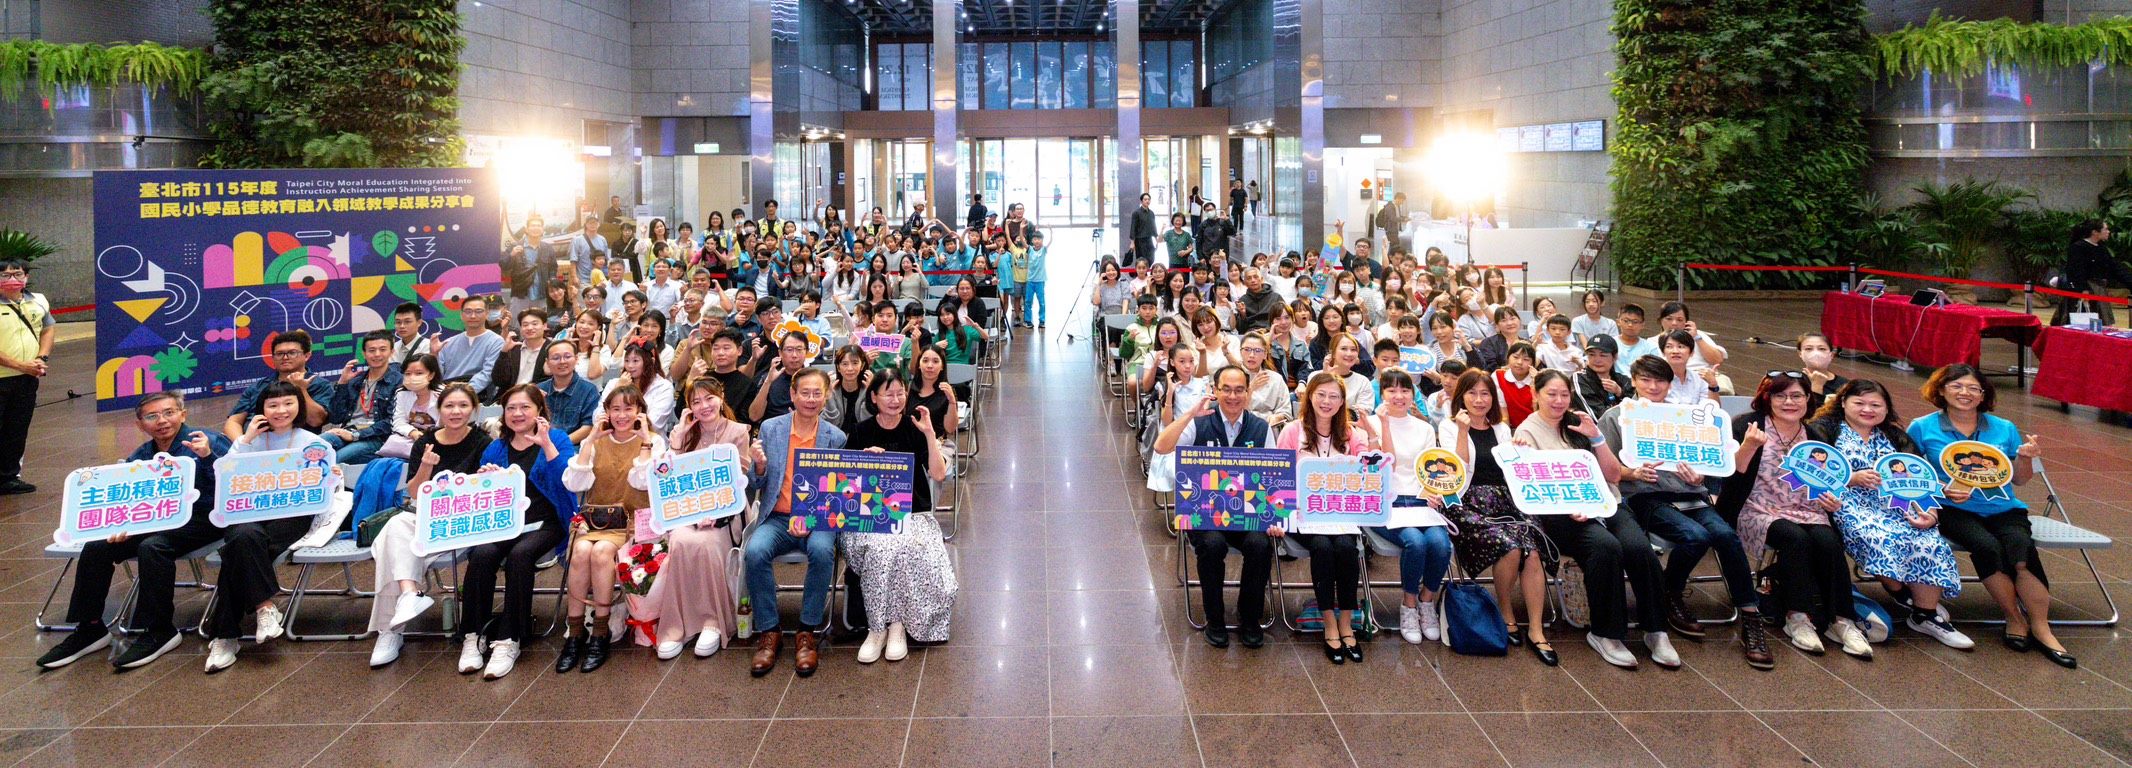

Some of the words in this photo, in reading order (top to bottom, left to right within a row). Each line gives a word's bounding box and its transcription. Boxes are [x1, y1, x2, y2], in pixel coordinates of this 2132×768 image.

[139, 181, 278, 198] 臺北市115年度
[286, 180, 314, 188] Taipei
[317, 179, 334, 188] City
[366, 178, 408, 186] Education
[411, 178, 453, 186] Integrated
[286, 187, 337, 195] Instruction
[340, 186, 396, 194] Achievement
[399, 185, 430, 194] Sharing
[140, 195, 475, 219] 國民小學品德教育融入領域教學成果分享會
[860, 336, 901, 350] 溫暖同行
[1635, 420, 1721, 444] 謙虛有禮
[1636, 440, 1722, 465] 愛護環境
[230, 468, 322, 494] 接納包容
[659, 465, 730, 497] 誠實信用
[1307, 473, 1382, 491] 孝親尊長
[1512, 461, 1590, 480] 尊重生命
[1794, 459, 1837, 486] 誠實信用
[79, 475, 180, 506] 主動積極
[1521, 482, 1601, 502] 公平正義
[1887, 480, 1930, 489] 誠實信用
[225, 488, 323, 511] SEL情緒學習
[430, 487, 513, 517] 關懷行善
[663, 487, 735, 519] 自主自律
[1307, 494, 1381, 513] 負責盡責
[78, 498, 179, 530] 團隊合作
[429, 509, 512, 540] 賞識感恩
